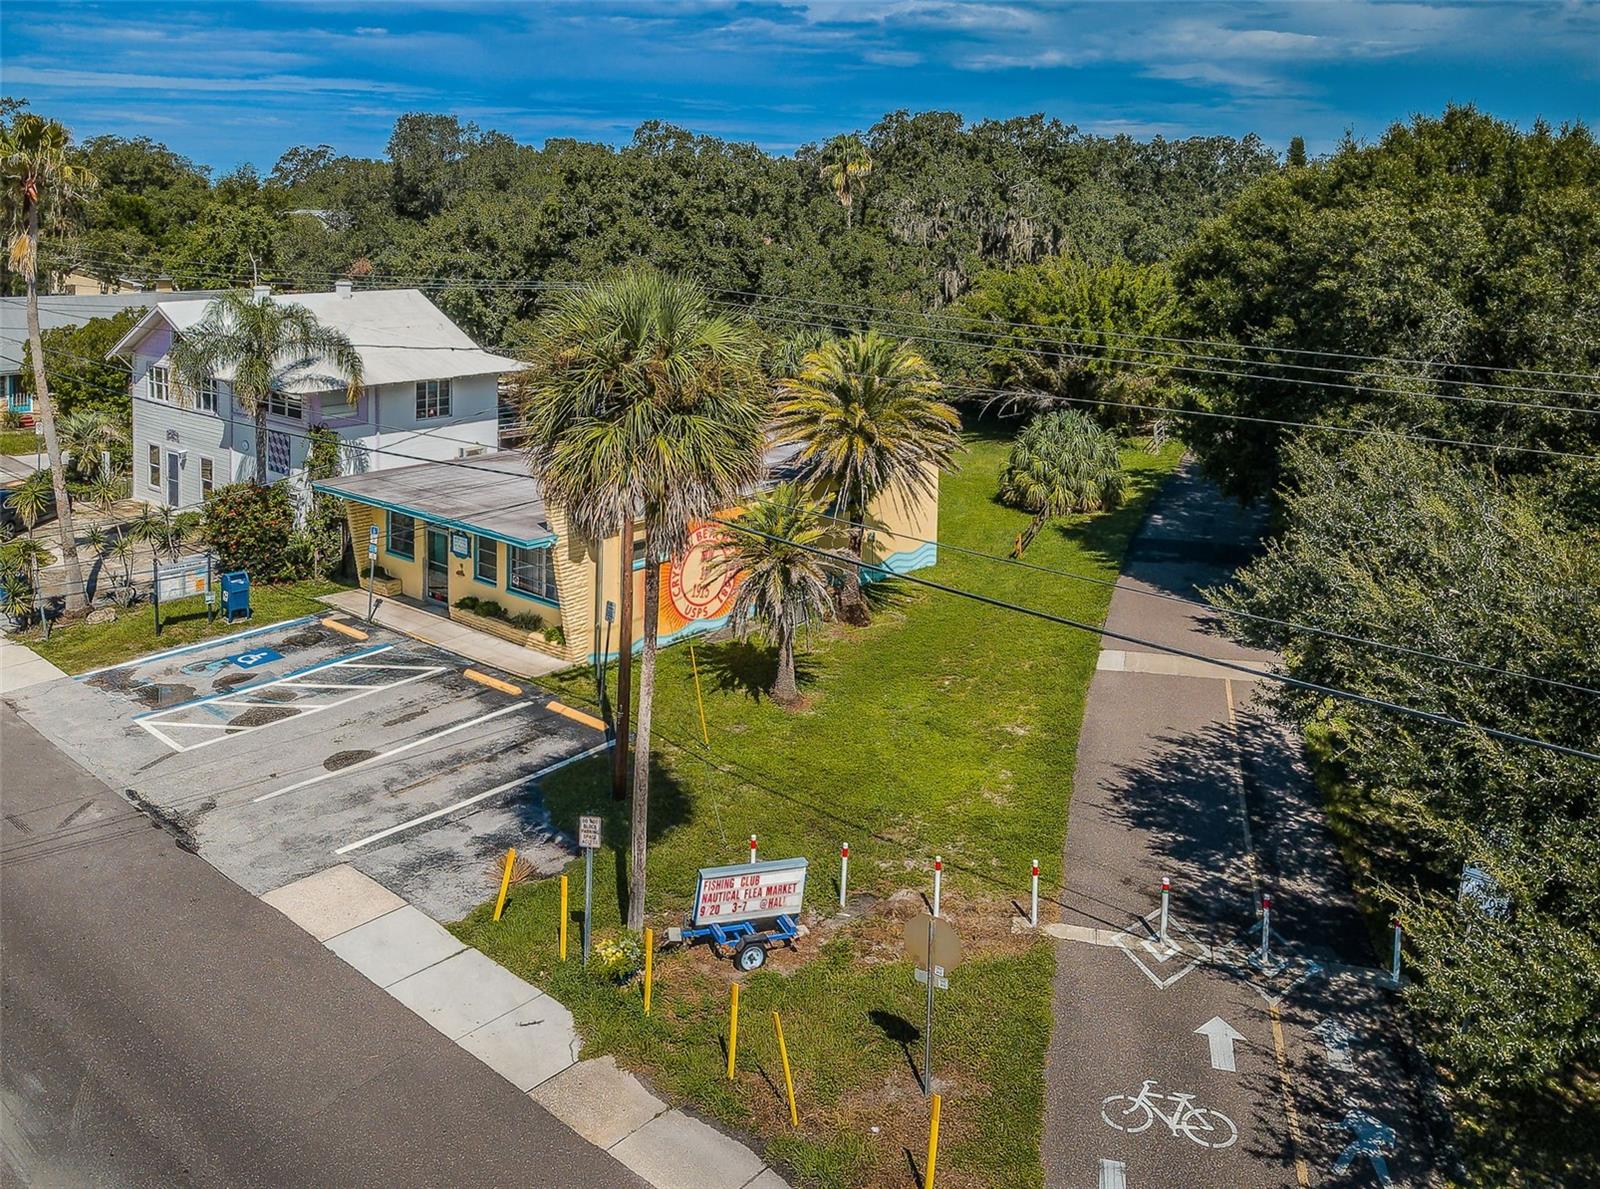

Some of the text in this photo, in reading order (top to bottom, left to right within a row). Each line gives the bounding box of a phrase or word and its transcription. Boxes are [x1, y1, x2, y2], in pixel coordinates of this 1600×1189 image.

[684, 604, 708, 618] USPS
[703, 875, 760, 890] FISHING CLUB
[702, 883, 797, 904] NAUTICAL FLEA MARKET
[732, 901, 747, 913] 3-7
